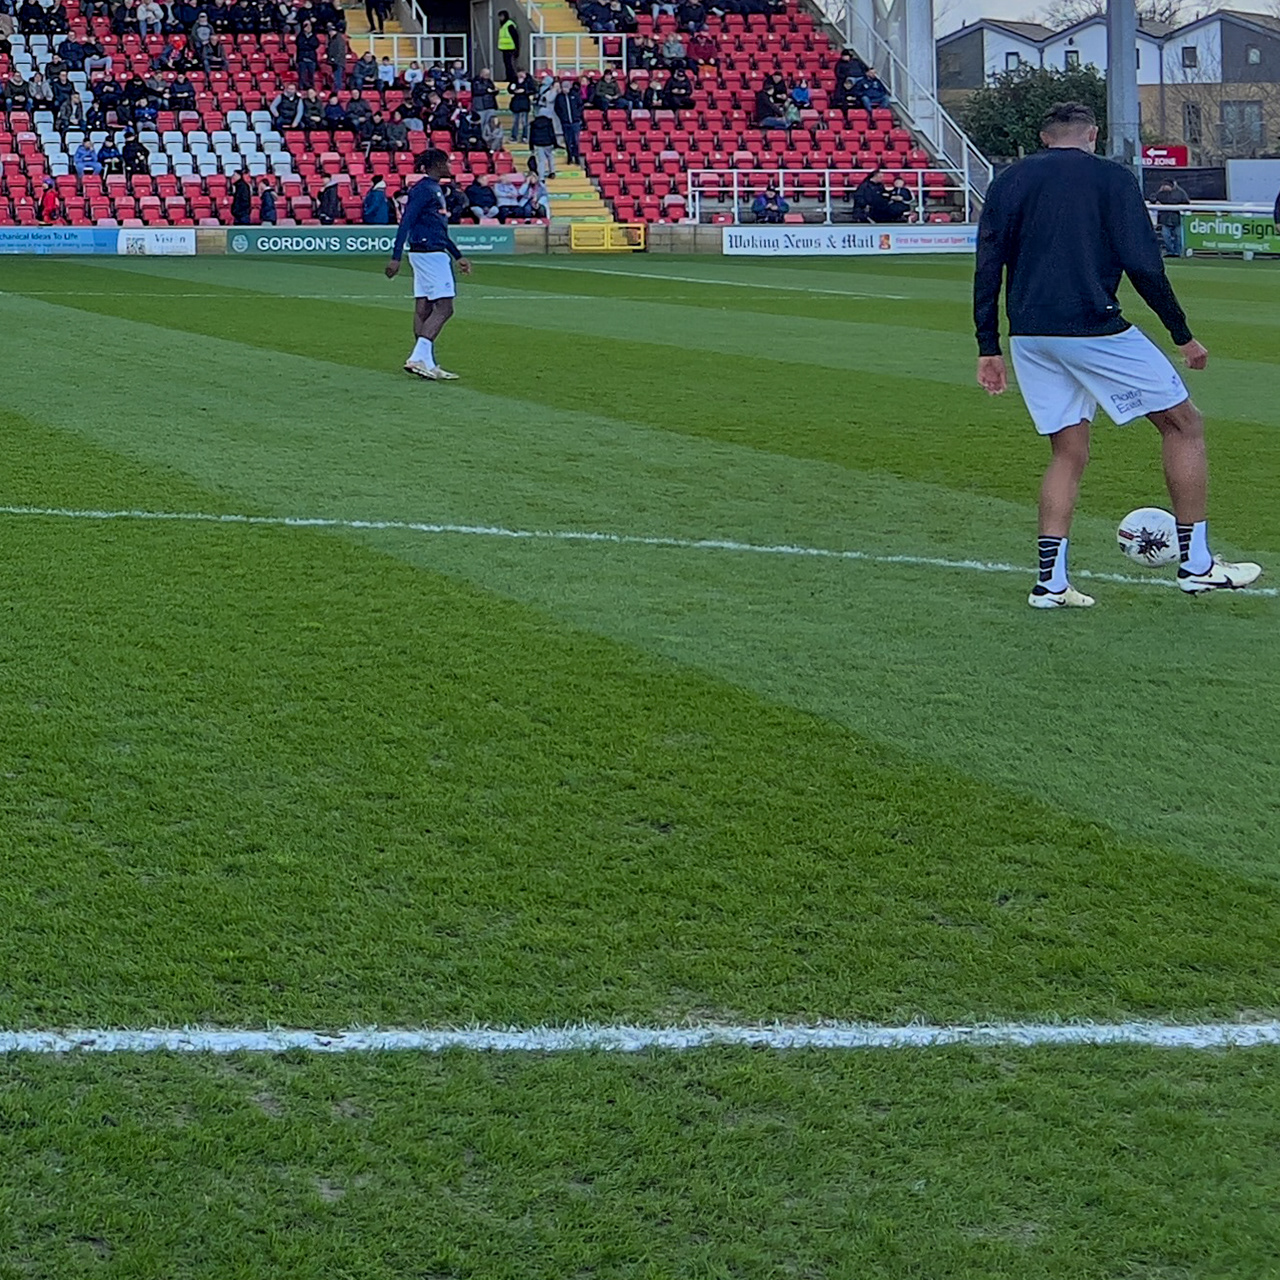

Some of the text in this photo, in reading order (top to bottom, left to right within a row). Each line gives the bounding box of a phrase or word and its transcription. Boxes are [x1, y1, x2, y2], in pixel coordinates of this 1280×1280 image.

[1189, 217, 1280, 240] darlingsign
[257, 237, 411, 251] GORDON'S SCHOL
[728, 233, 875, 252] Woking News & Mail
